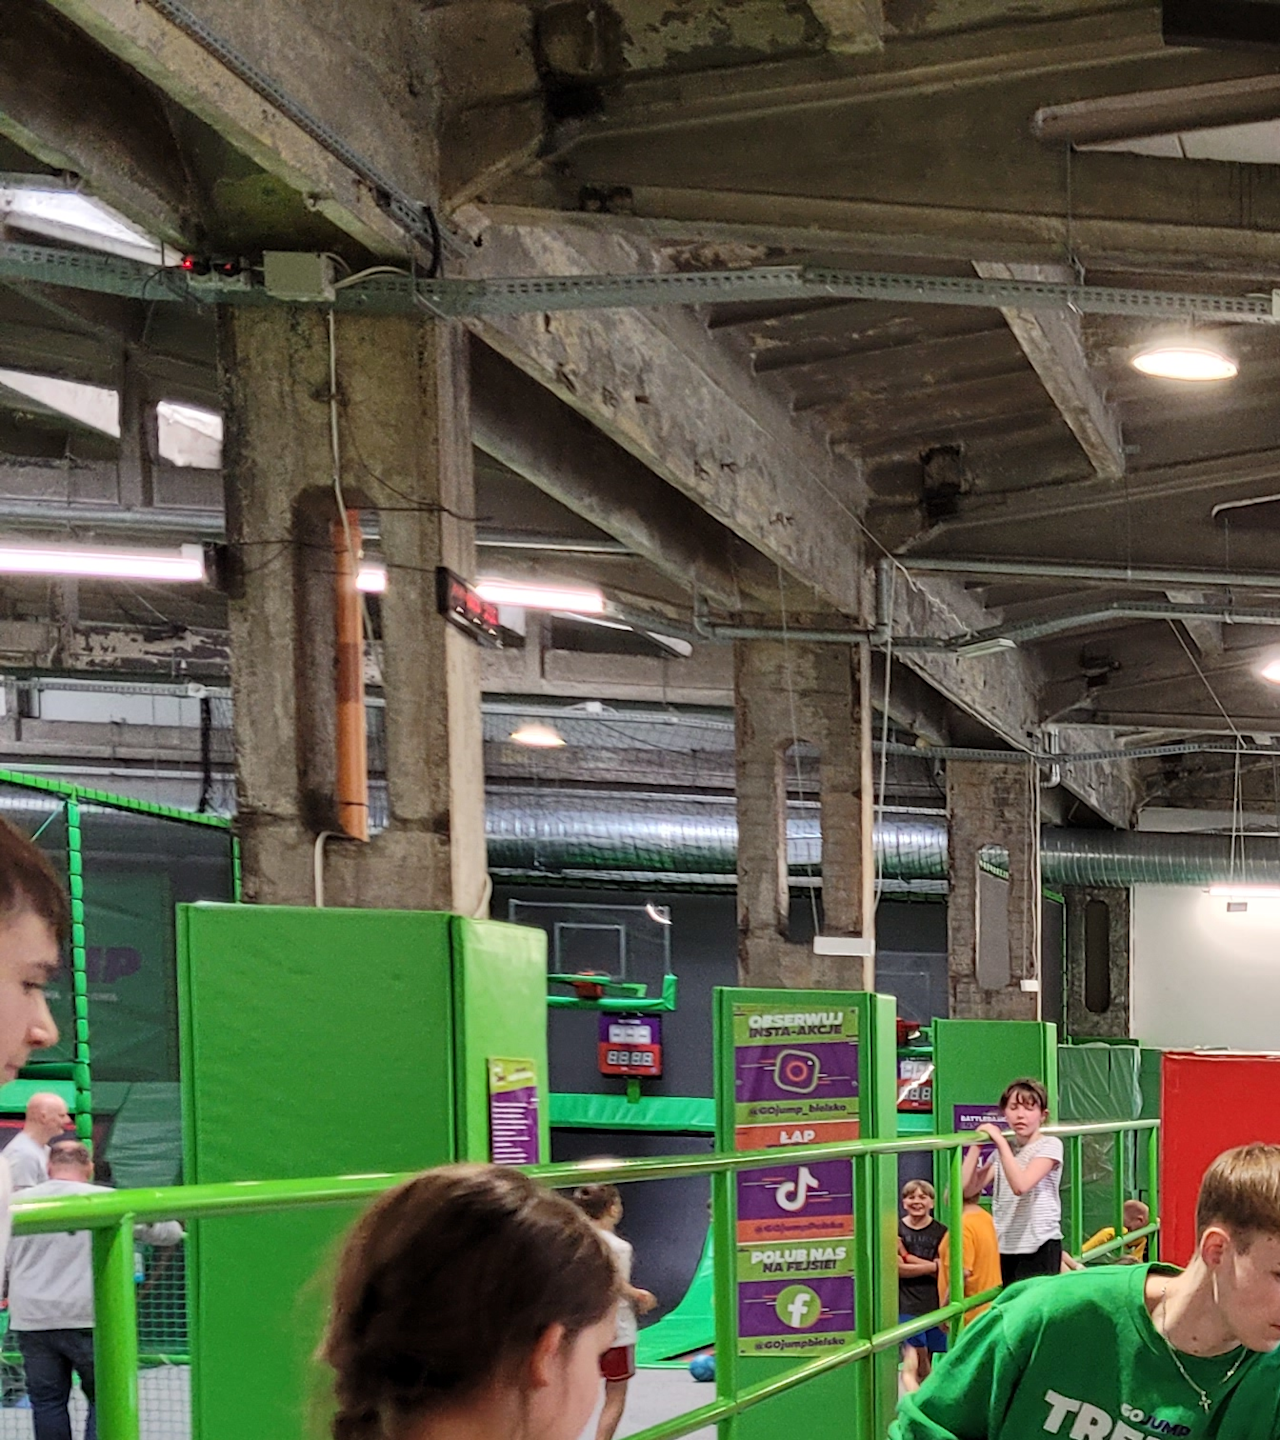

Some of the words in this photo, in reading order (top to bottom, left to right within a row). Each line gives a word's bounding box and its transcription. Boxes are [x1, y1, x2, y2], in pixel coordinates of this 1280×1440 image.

[748, 1012, 844, 1028] OBSERWUJ
[749, 1025, 842, 1038] INSTA-AKCJE
[779, 1130, 815, 1144] ŁAP
[751, 1248, 807, 1264] POLUB
[810, 1247, 846, 1261] NAS
[763, 1263, 783, 1273] NA
